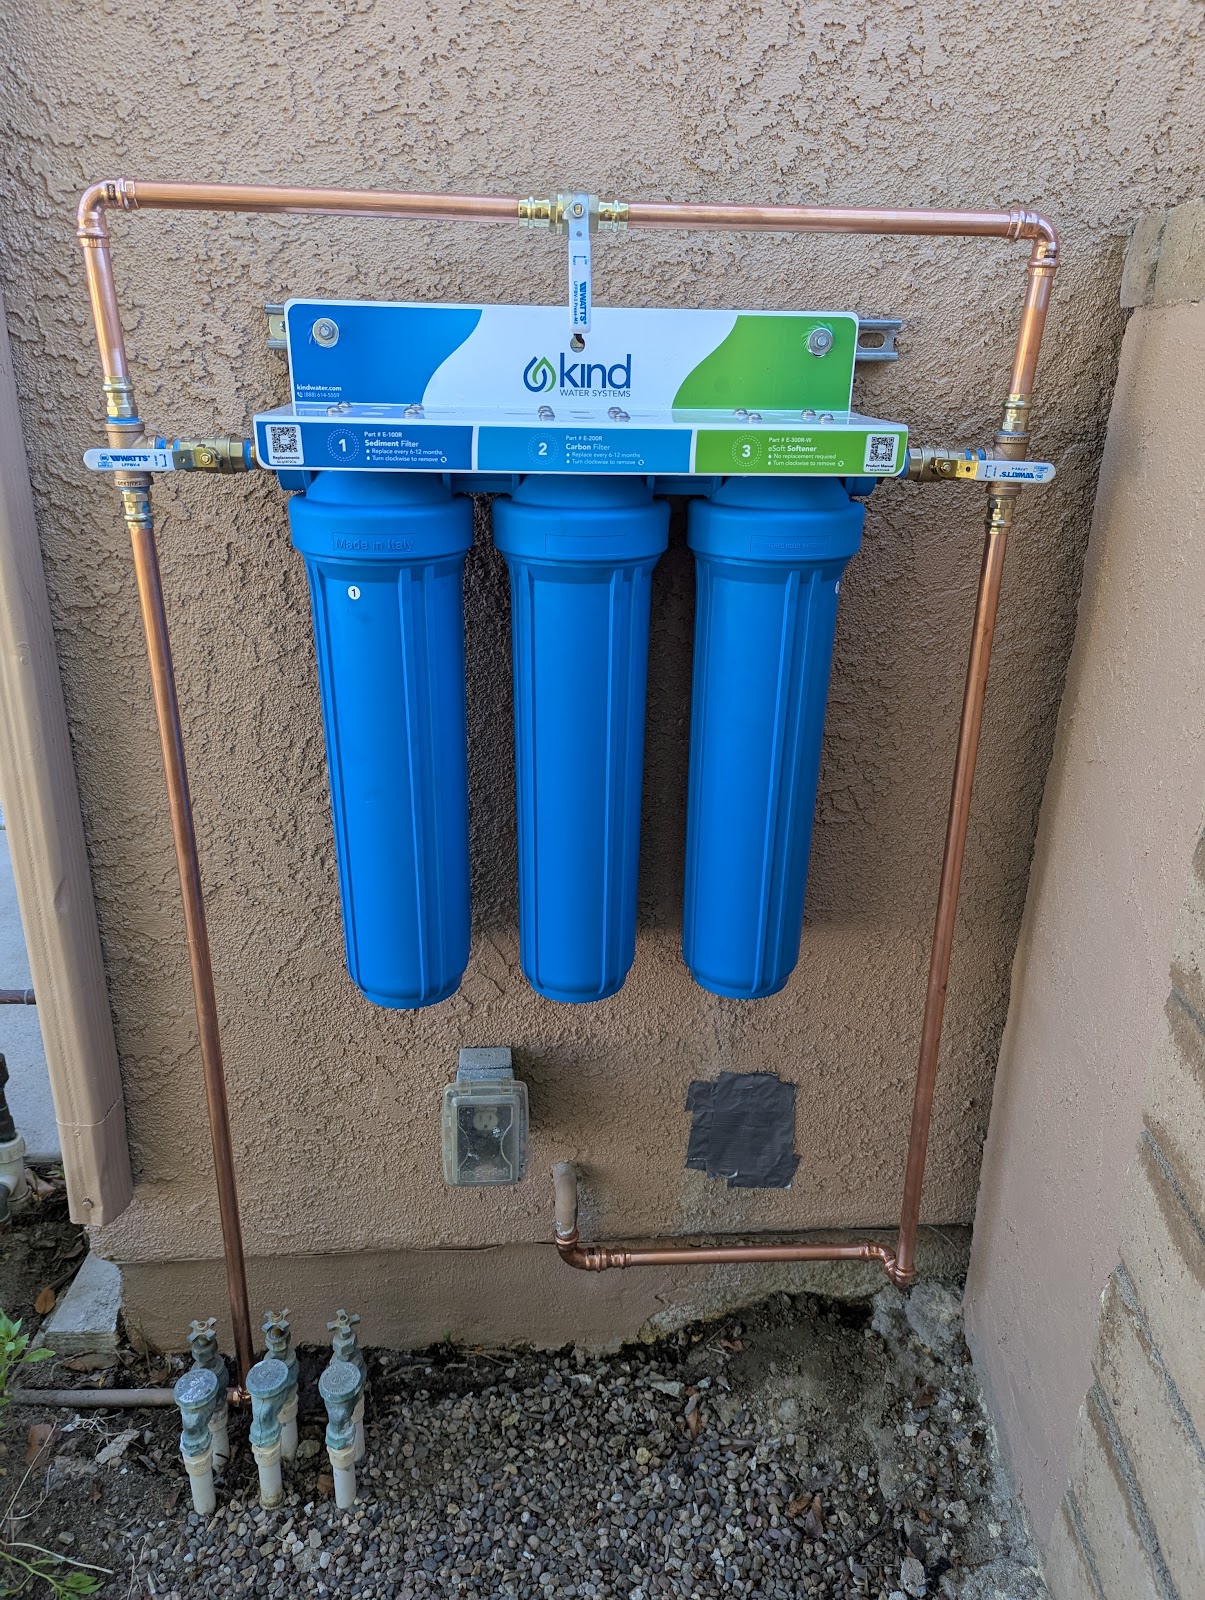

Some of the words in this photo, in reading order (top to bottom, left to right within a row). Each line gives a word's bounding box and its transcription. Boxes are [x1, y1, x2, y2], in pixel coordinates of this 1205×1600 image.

[560, 352, 632, 389] kind
[296, 384, 342, 392] kindwater.com
[560, 389, 590, 397] WATER
[592, 390, 631, 398] SYSTEMS
[338, 438, 346, 452] 1
[538, 442, 548, 456] 2
[742, 444, 751, 458] 3
[336, 538, 368, 550] Made
[372, 540, 383, 550] in
[387, 540, 414, 552] Italy
[352, 588, 356, 598] 1
